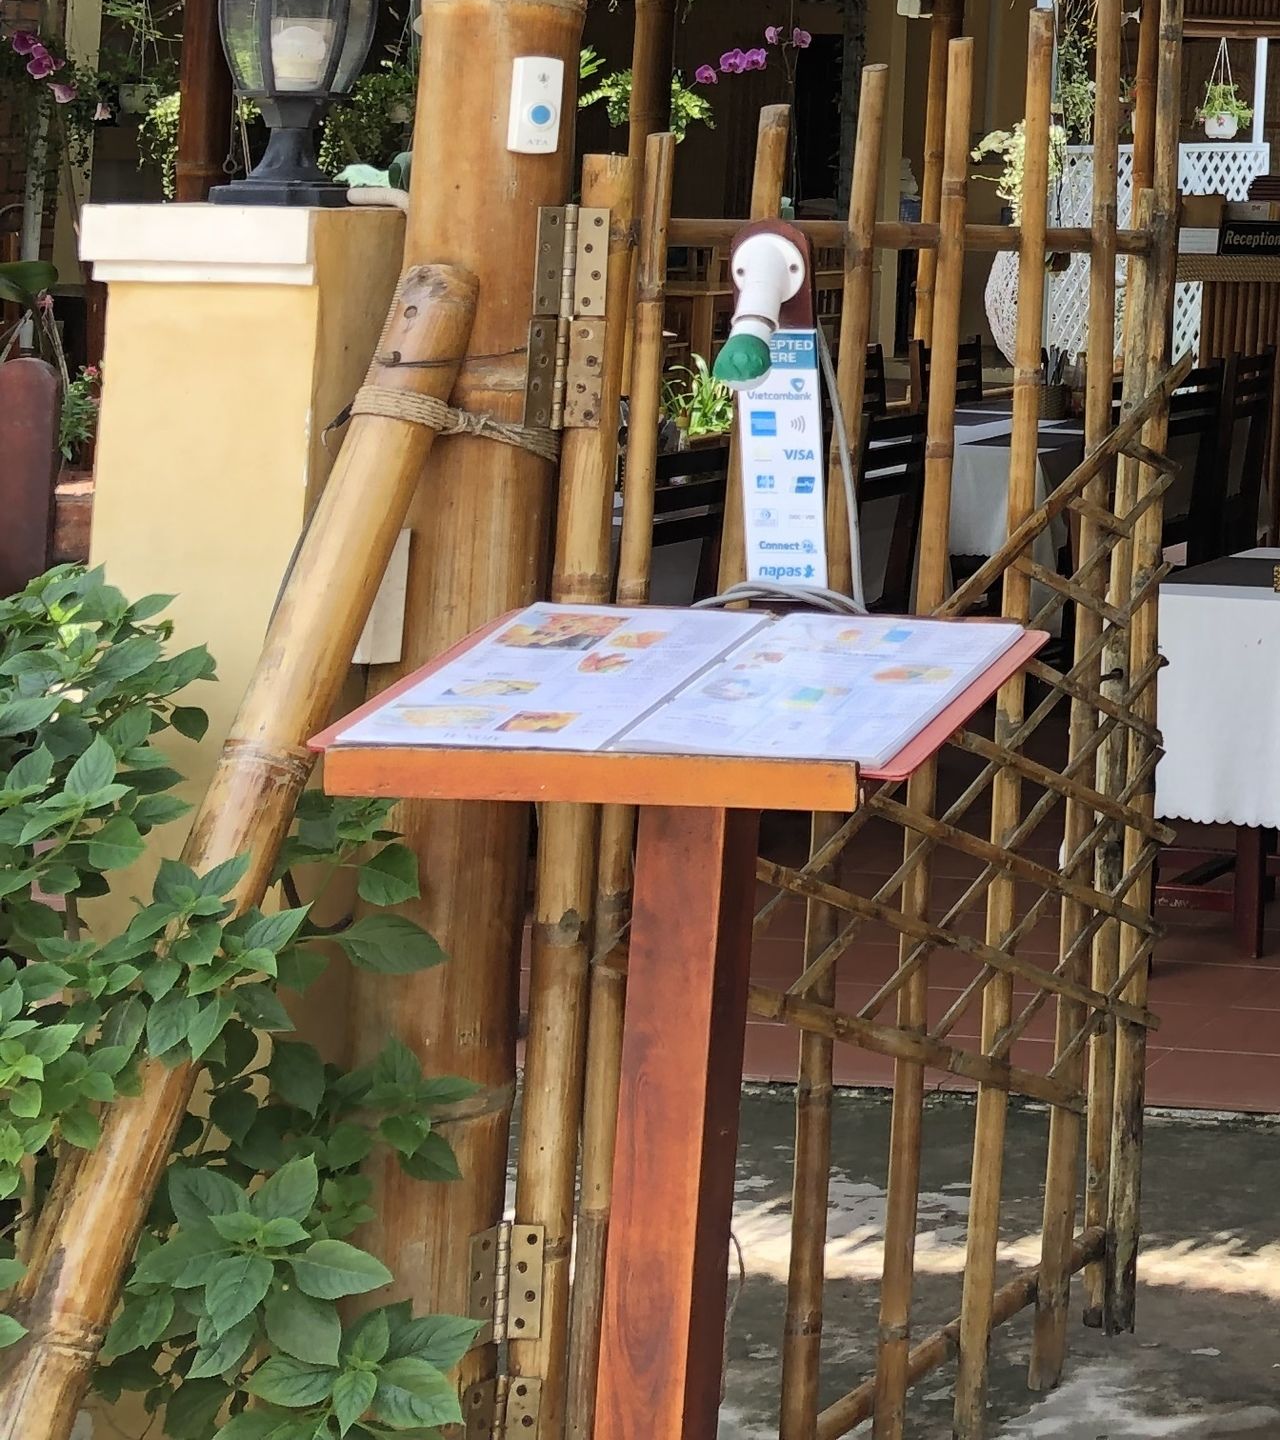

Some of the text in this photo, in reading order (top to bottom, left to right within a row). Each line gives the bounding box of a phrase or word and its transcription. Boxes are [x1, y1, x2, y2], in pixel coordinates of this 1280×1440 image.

[768, 352, 797, 362] ERE
[747, 391, 811, 401] Vietcombank
[783, 449, 815, 460] VISA
[759, 540, 800, 551] Connect
[758, 566, 802, 580] napas
